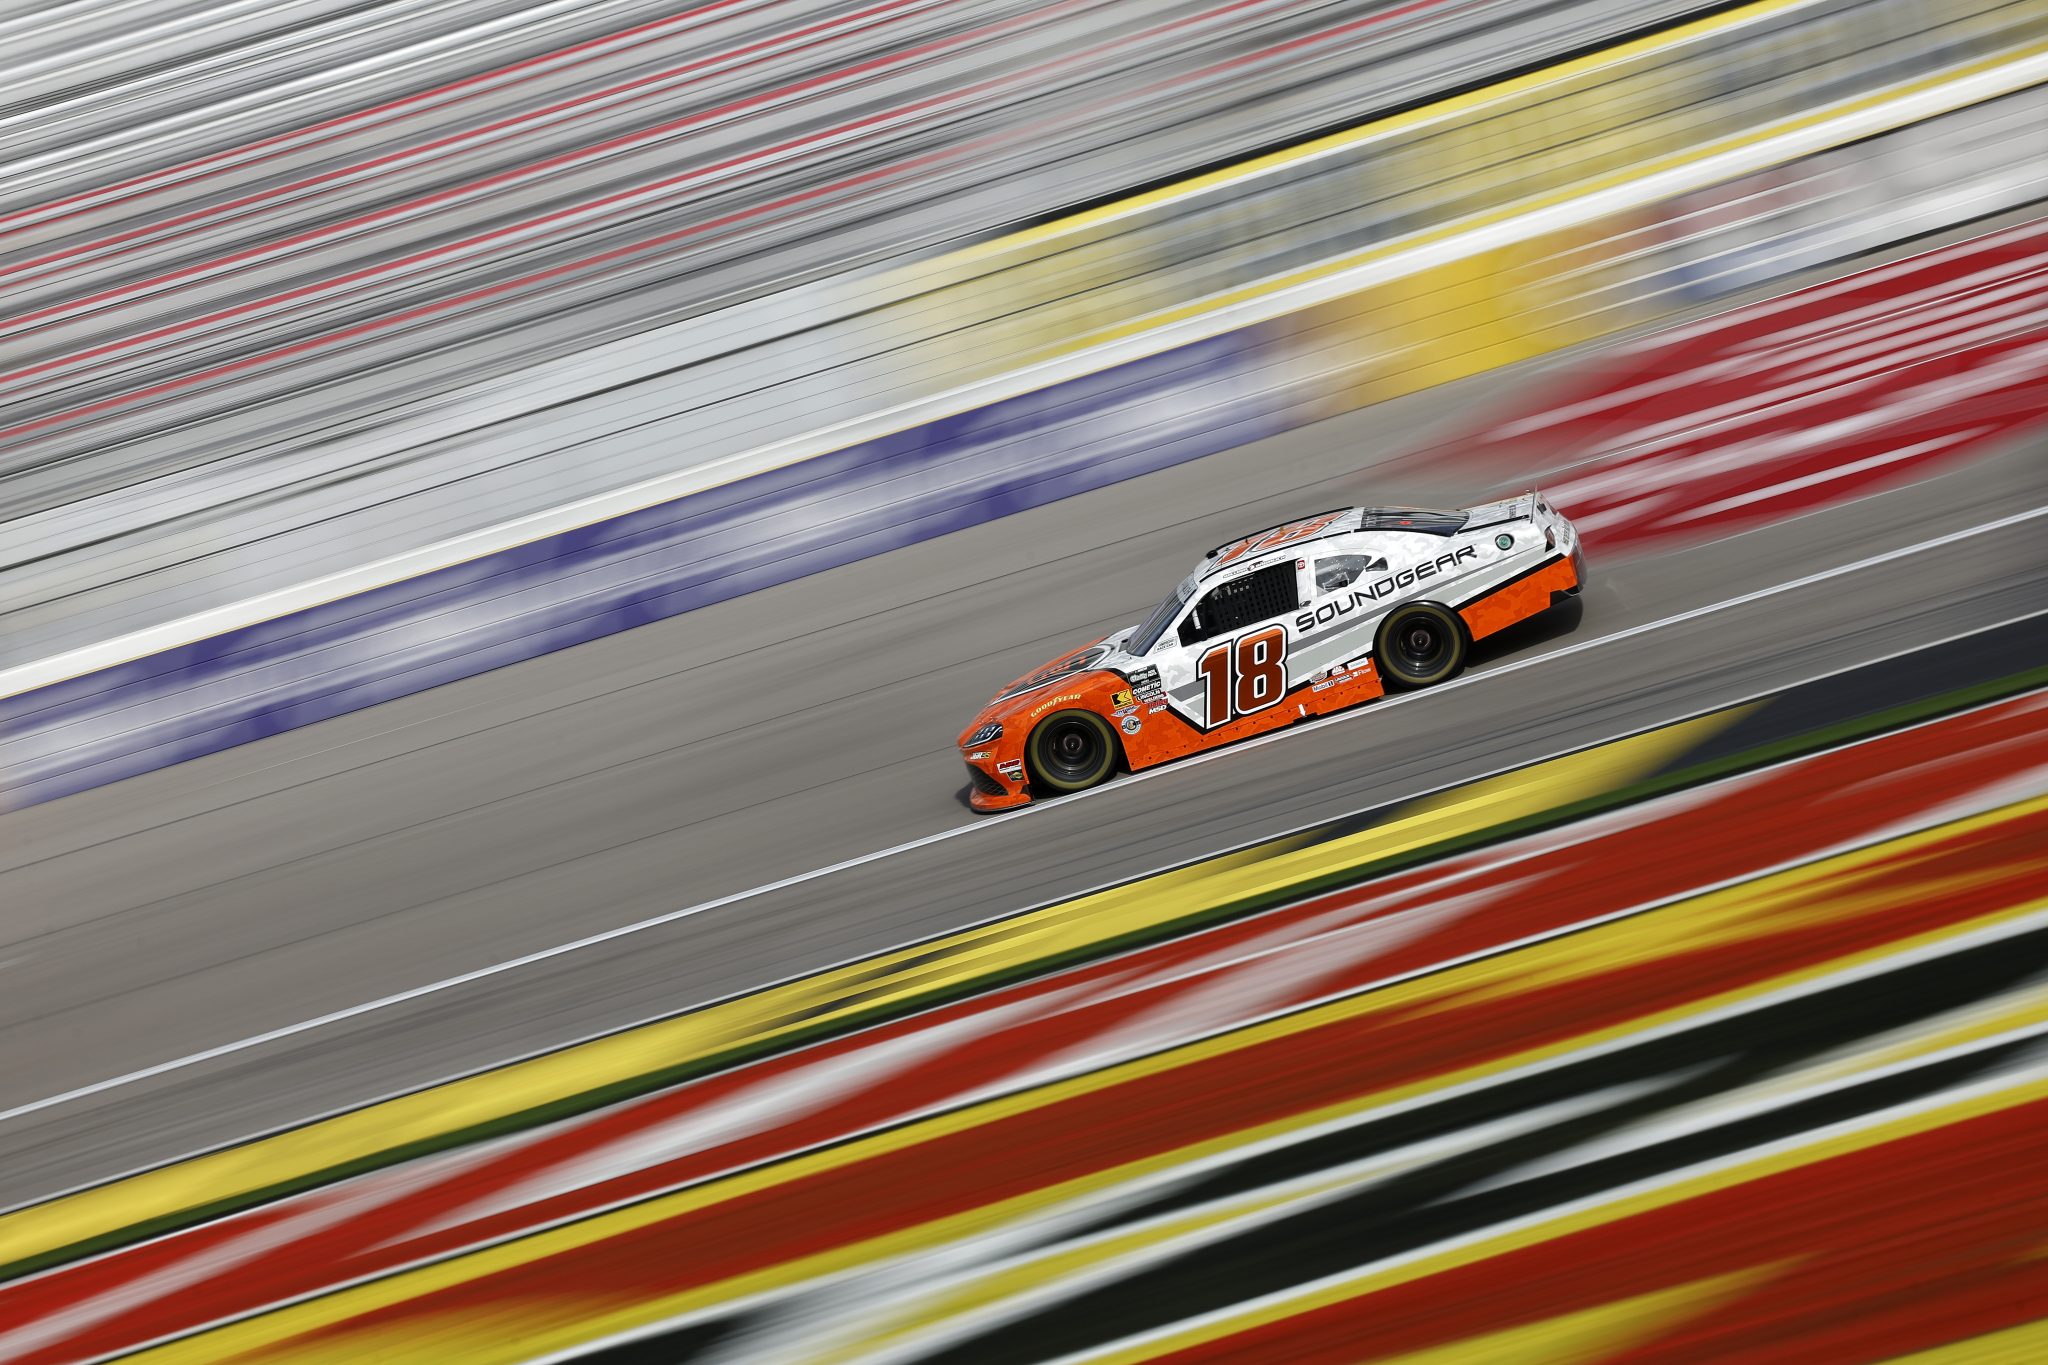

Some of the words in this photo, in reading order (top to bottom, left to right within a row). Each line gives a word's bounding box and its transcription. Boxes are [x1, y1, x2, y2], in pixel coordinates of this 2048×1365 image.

[1296, 545, 1478, 633] SOUNDGEAR
[1132, 681, 1161, 695] COMETIC
[1196, 623, 1289, 730] 18
[1030, 693, 1081, 718] GOODYEAR
[1148, 704, 1168, 715] MSD
